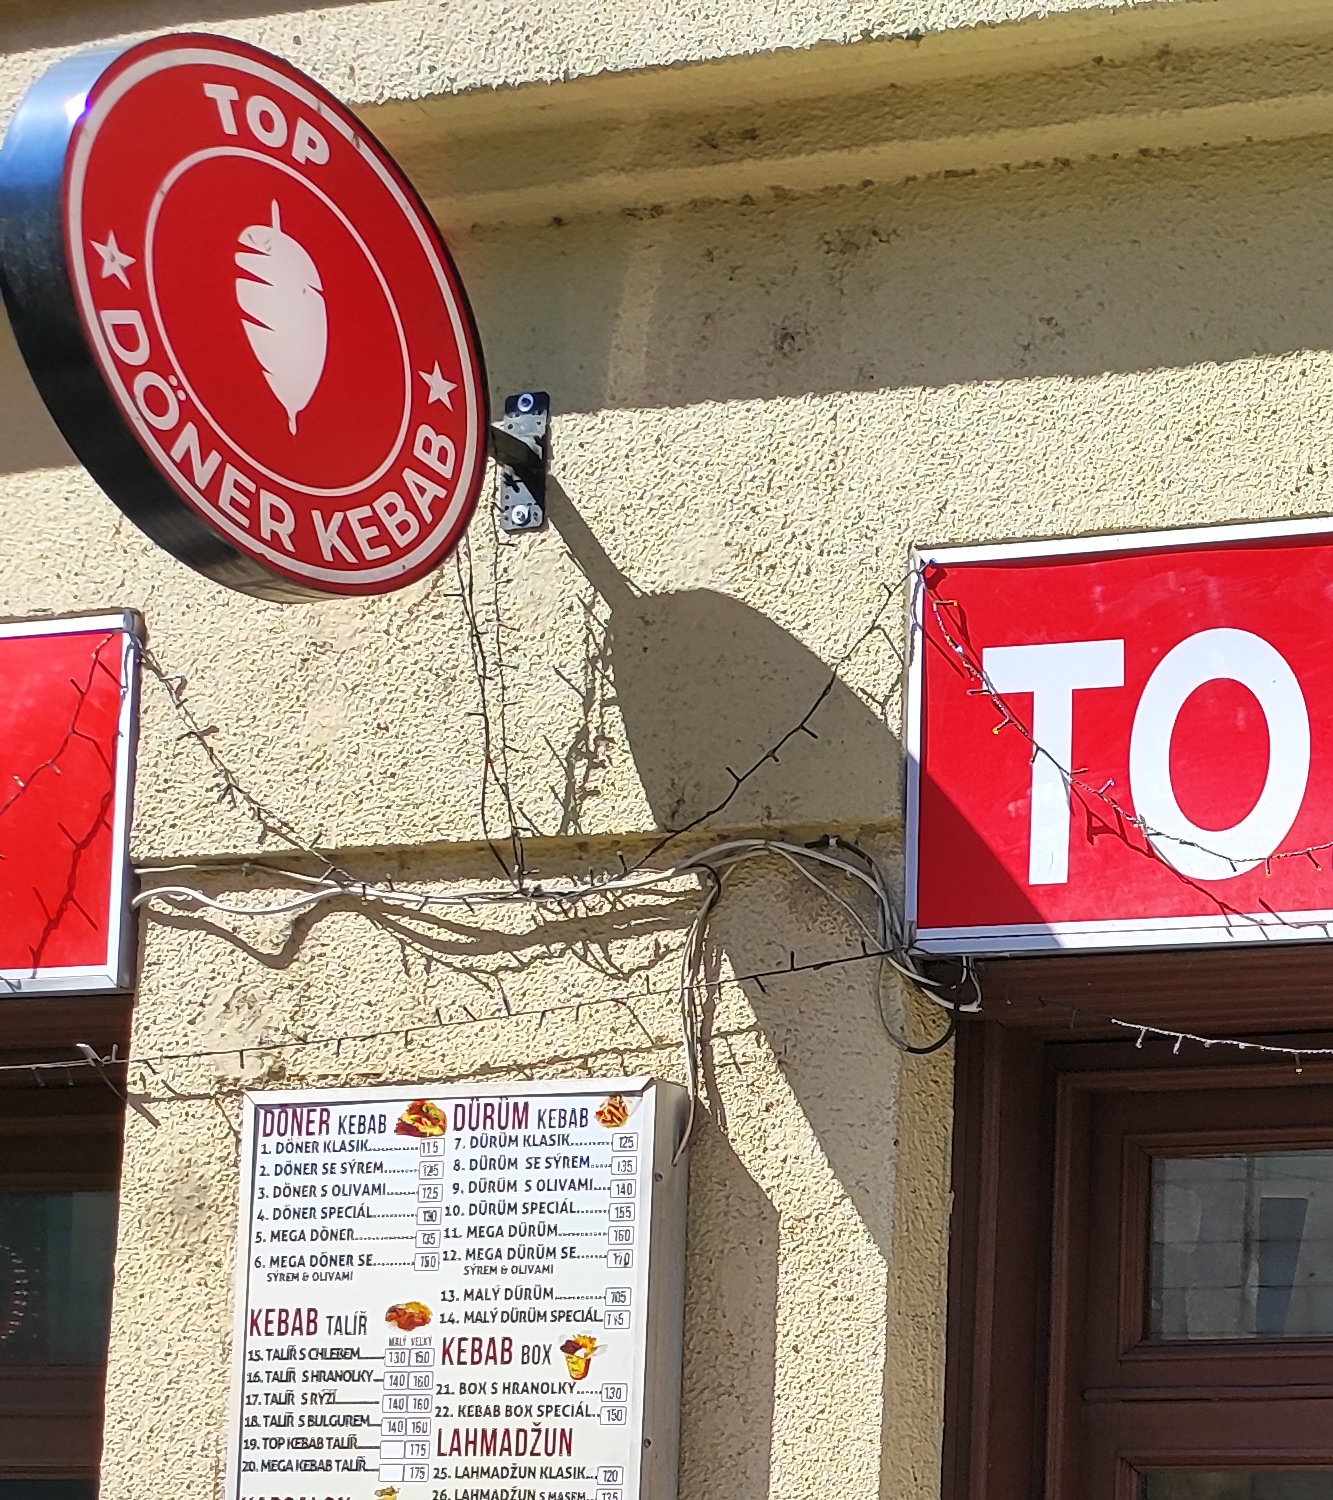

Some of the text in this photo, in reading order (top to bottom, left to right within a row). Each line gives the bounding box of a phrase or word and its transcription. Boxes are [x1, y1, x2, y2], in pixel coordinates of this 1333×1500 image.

[203, 82, 330, 166] TOP
[100, 310, 456, 564] DÖNER KEBAB
[453, 1098, 588, 1131] DÜRÜM KEBAB
[338, 1114, 387, 1135] KEBAB
[276, 1138, 369, 1154] DÖNER KLASIK
[470, 1132, 570, 1149] DÜRÜM KLASIK
[274, 1160, 384, 1176] DÖNER SE SÝREM
[469, 1153, 590, 1171] DÜRÜM SE SÝREM
[273, 1182, 386, 1198] DÖNER S OLIVAMI
[468, 1178, 594, 1193] DÜRÜM S OLIVAMI
[273, 1203, 371, 1220] DÖNER SPECIÁL
[469, 1198, 576, 1216] DÜRÜM SPECIÁL
[270, 1226, 353, 1242] MEGA DÖNER
[467, 1222, 558, 1238] MEGA DÜRÜM
[269, 1252, 373, 1267] MEGA DÖNER SE
[466, 1245, 577, 1261] MEGA DÜRÜM SE
[267, 1270, 353, 1282] SÝREM OLIVAMI
[463, 1264, 553, 1275] SÝREM OLIVAMI
[464, 1284, 554, 1301] MALÝ DÜRÜM
[250, 1308, 367, 1337] KEBAB TALÍŘ
[464, 1307, 498, 1324] MALÝ
[500, 1307, 547, 1323] DÜRÜM
[441, 1337, 552, 1366] KEBAB BOX
[265, 1367, 296, 1383] TALÍŘ
[459, 1381, 577, 1395] BOX S HRANOLKY
[458, 1401, 591, 1417] KEBAB BOX SPECIÁL
[264, 1412, 294, 1428] TALÍŘ
[262, 1438, 285, 1449] TOP
[287, 1438, 324, 1449] KEBAB
[437, 1422, 573, 1457] LAHMADŽUN
[261, 1459, 293, 1472] MEGA
[296, 1460, 332, 1472] KEBAB
[455, 1463, 585, 1479] LAHMADŽUN KLASIK
